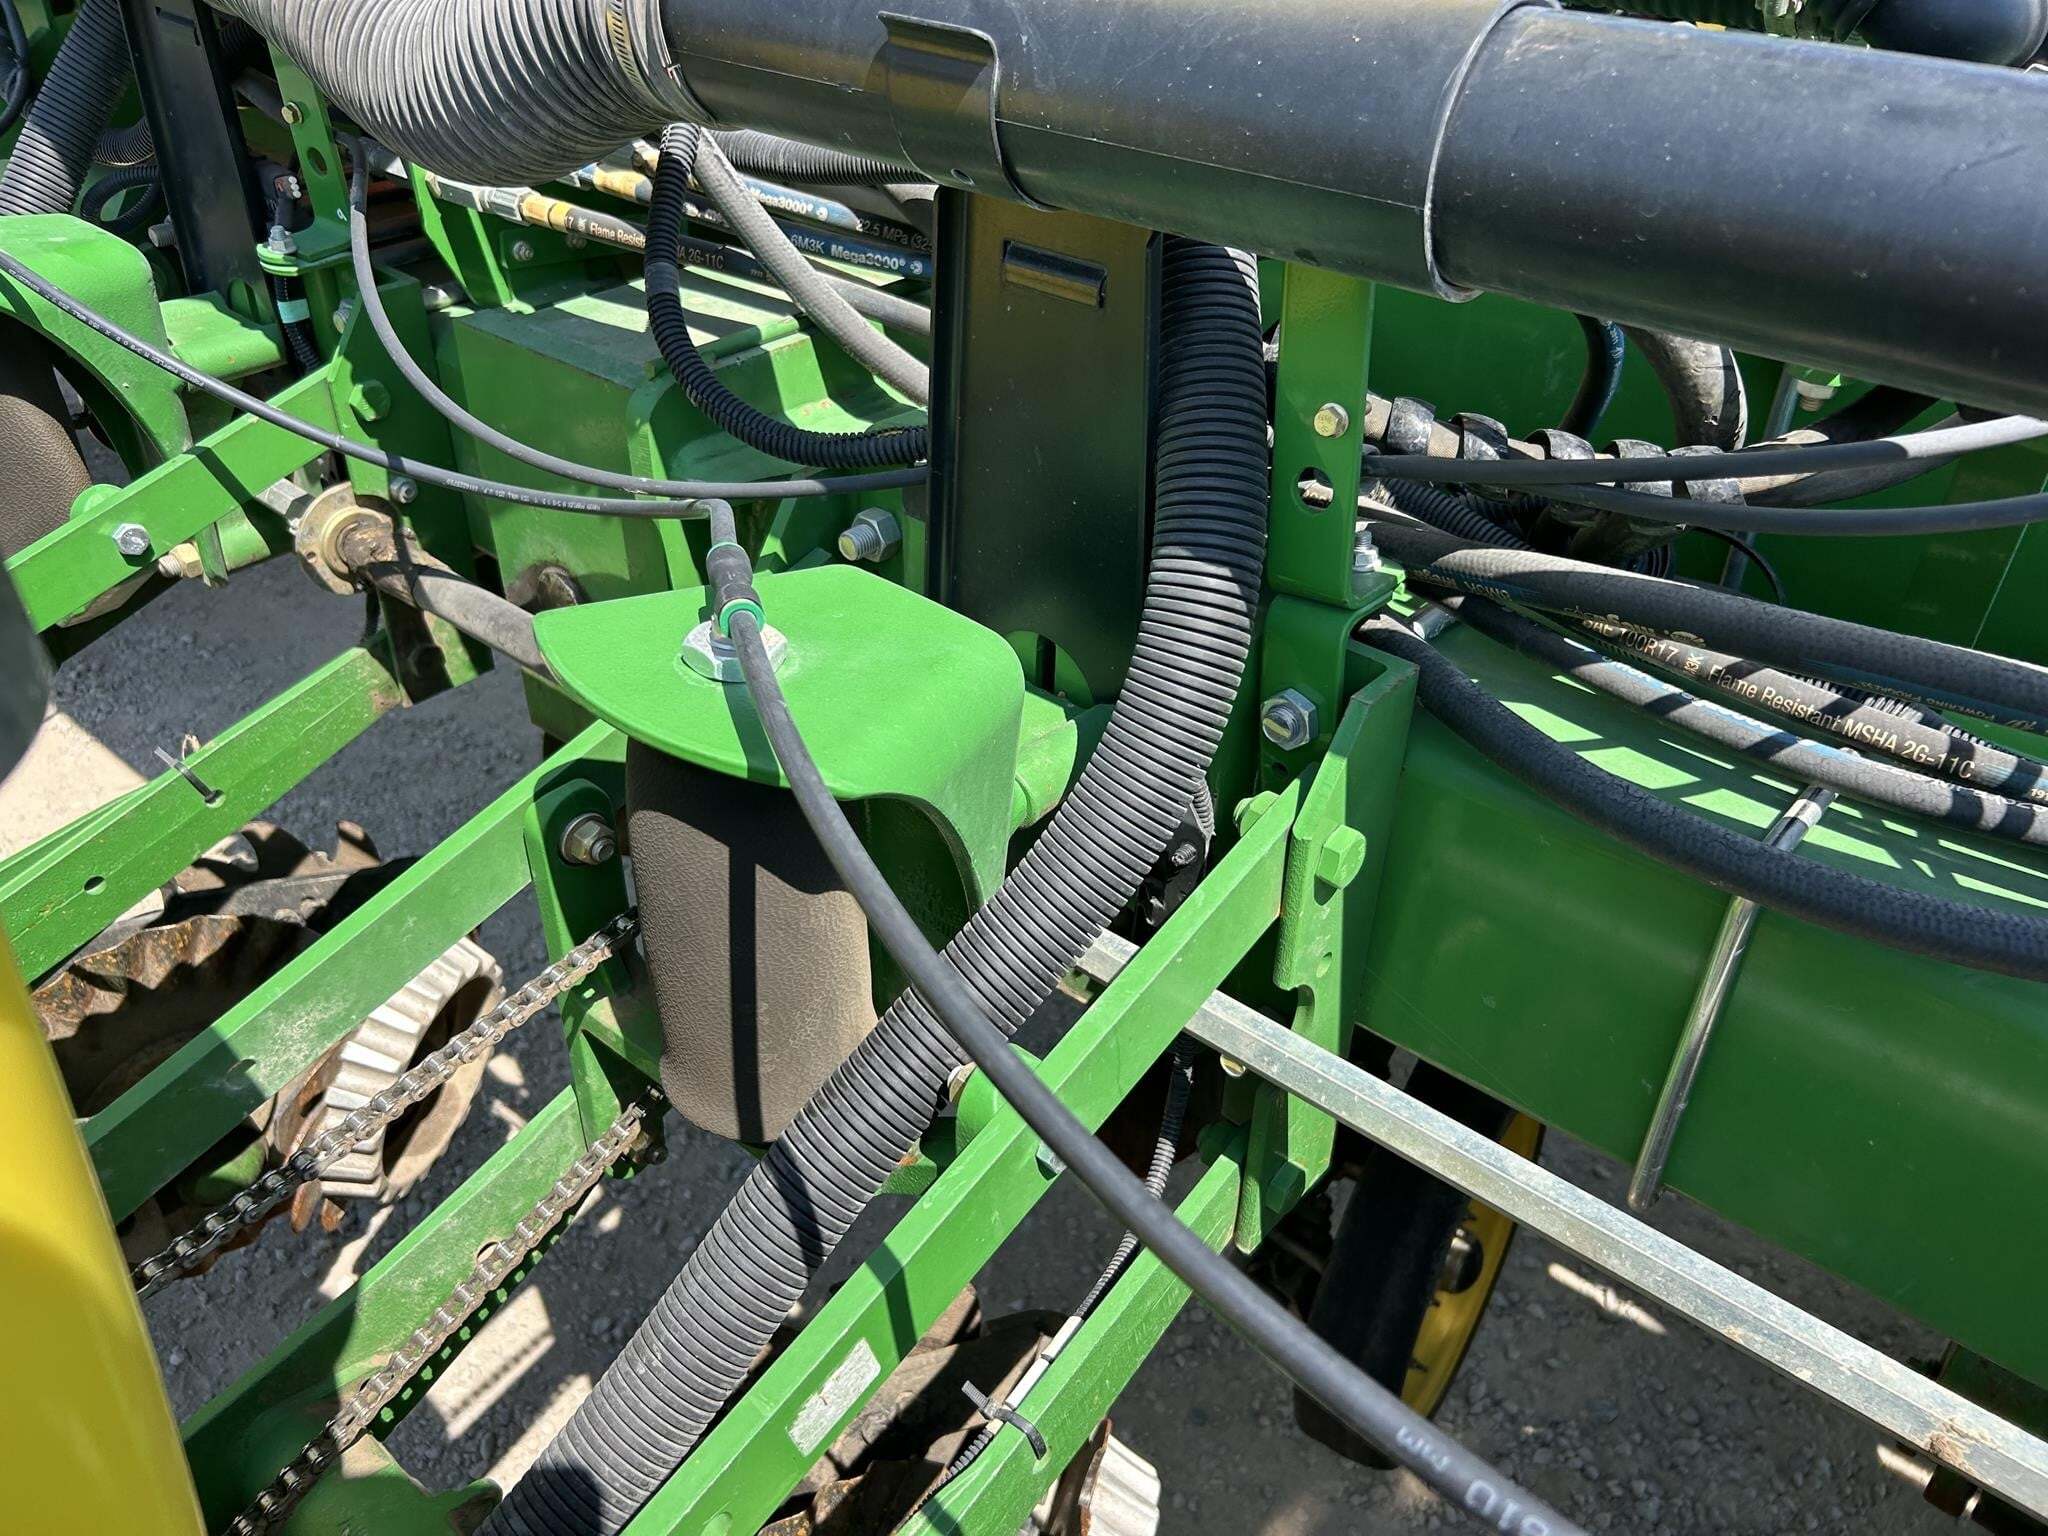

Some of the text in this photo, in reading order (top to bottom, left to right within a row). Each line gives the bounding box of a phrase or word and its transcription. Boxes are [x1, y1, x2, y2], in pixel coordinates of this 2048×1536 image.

[590, 222, 616, 240] Flame
[688, 248, 724, 270] 2G-11C
[1707, 664, 1757, 698] Flame
[1761, 685, 1842, 731] Resistant
[1843, 718, 1898, 754] MSHA
[1901, 739, 1976, 780] 2G-11C
